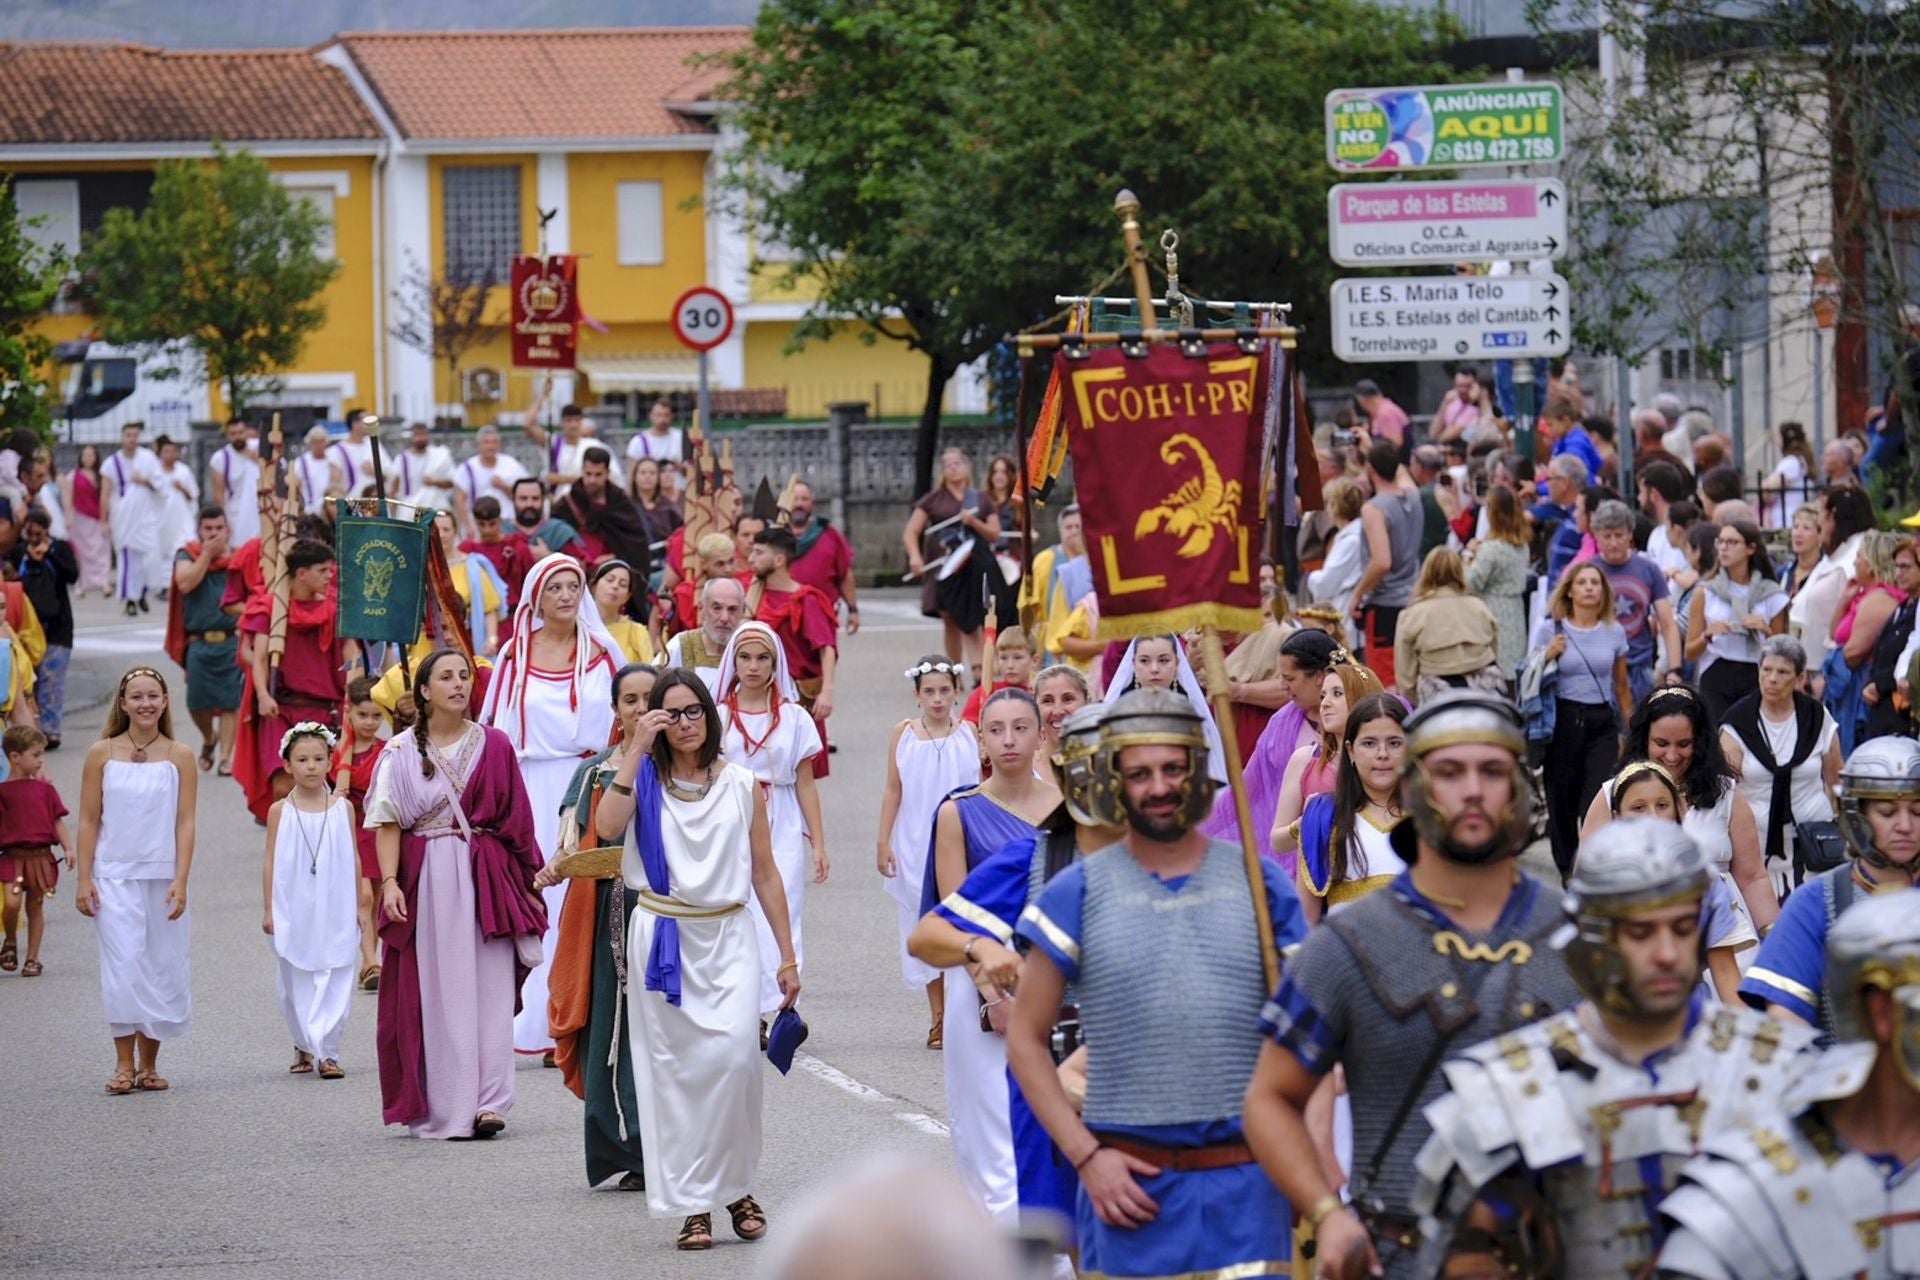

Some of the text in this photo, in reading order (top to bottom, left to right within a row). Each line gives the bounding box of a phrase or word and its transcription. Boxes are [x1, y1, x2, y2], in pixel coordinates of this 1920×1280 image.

[1433, 91, 1552, 112] ANÚNCIATE
[1352, 112, 1383, 128] VEN
[1439, 108, 1548, 139] AQUÍ
[1339, 130, 1376, 143] NO
[1453, 141, 1485, 161] 619
[1488, 139, 1519, 159] 472
[1347, 190, 1507, 219] Parque de las Estelas
[1422, 225, 1470, 239] O.C.A.
[1353, 239, 1539, 256] Oficina Comarcal Agraria
[1348, 285, 1398, 303] I.E.S.
[1466, 282, 1504, 300] Telo
[686, 308, 721, 329] 30
[1349, 311, 1390, 328] I.E.S.
[1396, 308, 1451, 326] Estelas
[1456, 308, 1480, 324] del
[1350, 334, 1437, 354] Torrelavega
